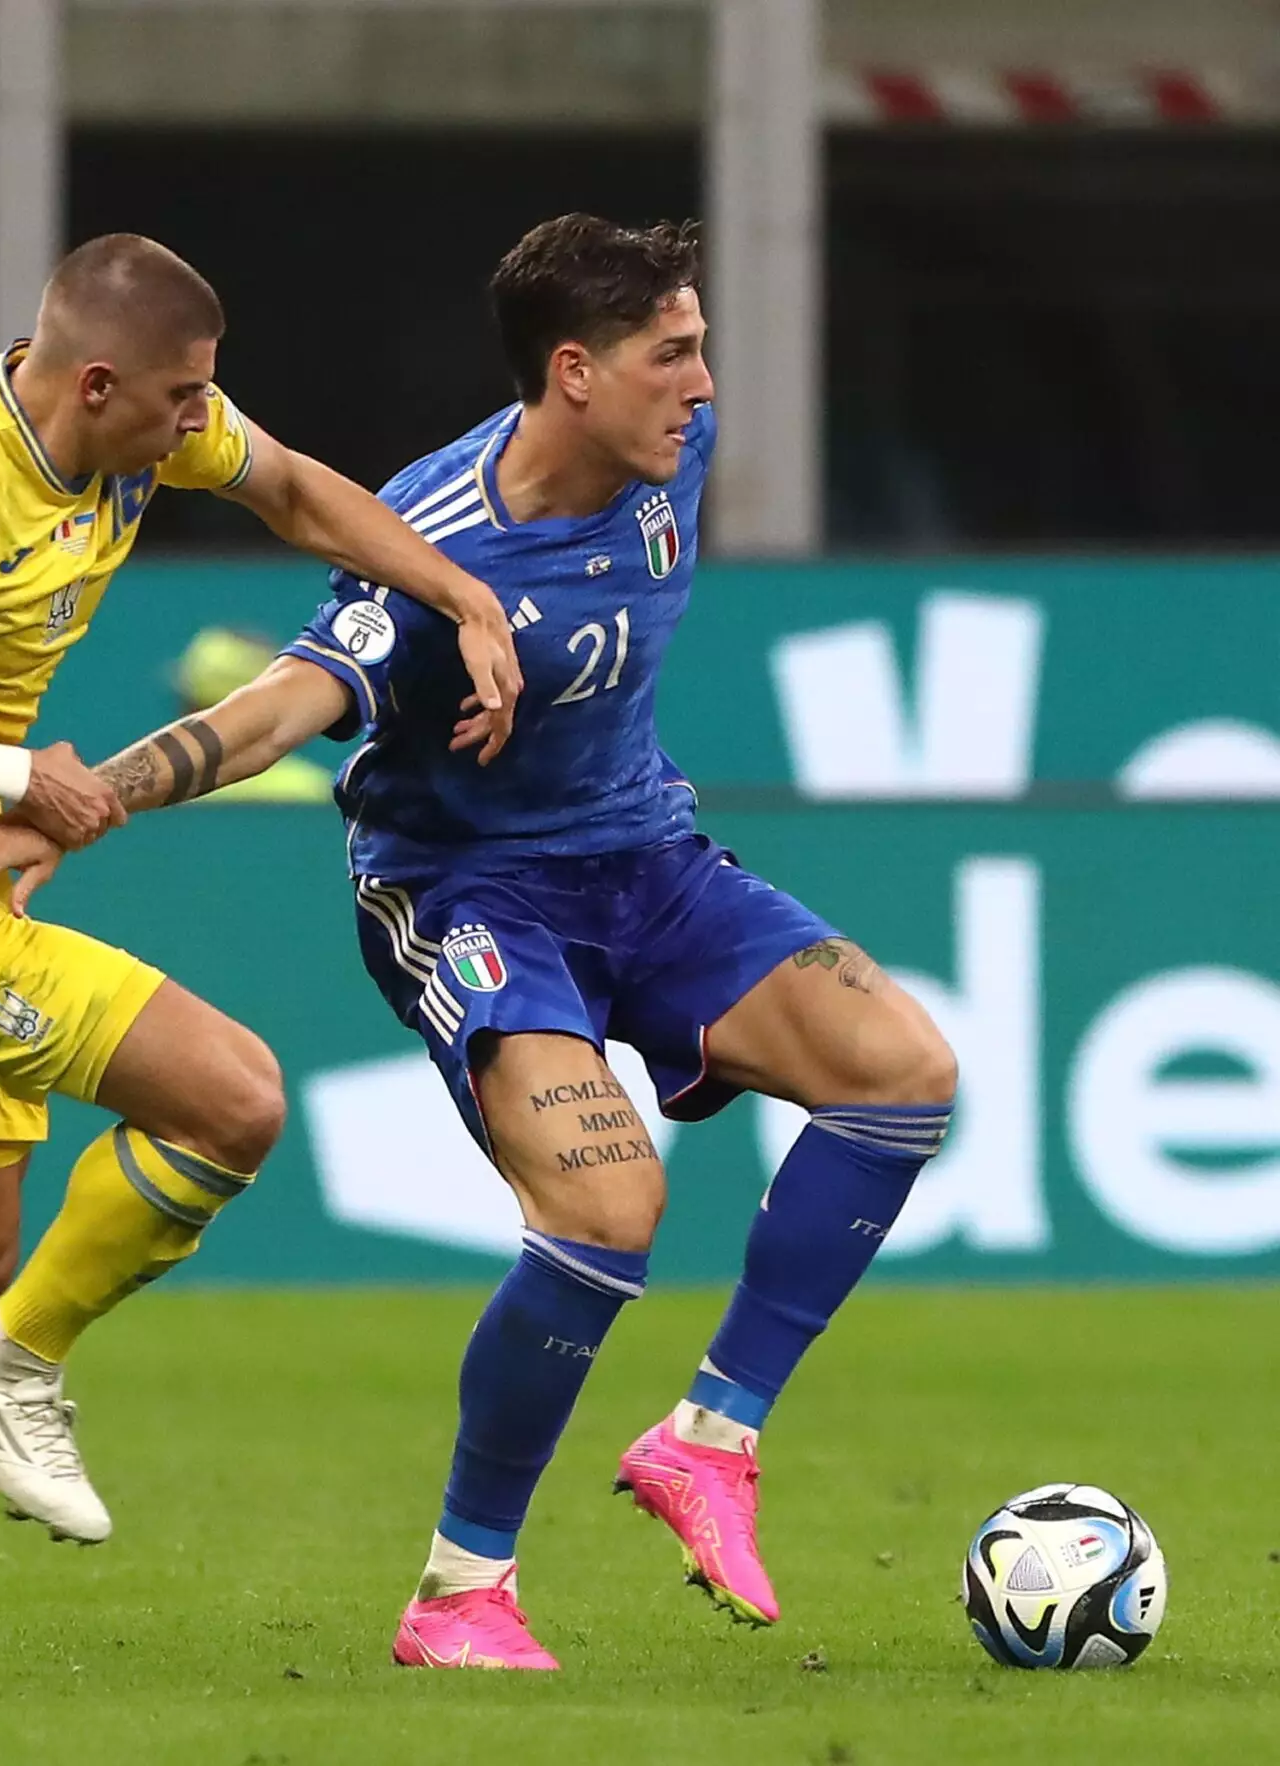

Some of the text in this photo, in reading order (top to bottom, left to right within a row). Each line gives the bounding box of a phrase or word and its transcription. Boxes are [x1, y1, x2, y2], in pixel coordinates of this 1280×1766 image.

[644, 508, 672, 538] ITALIA
[551, 607, 630, 706] 21
[448, 935, 492, 959] ITALIA
